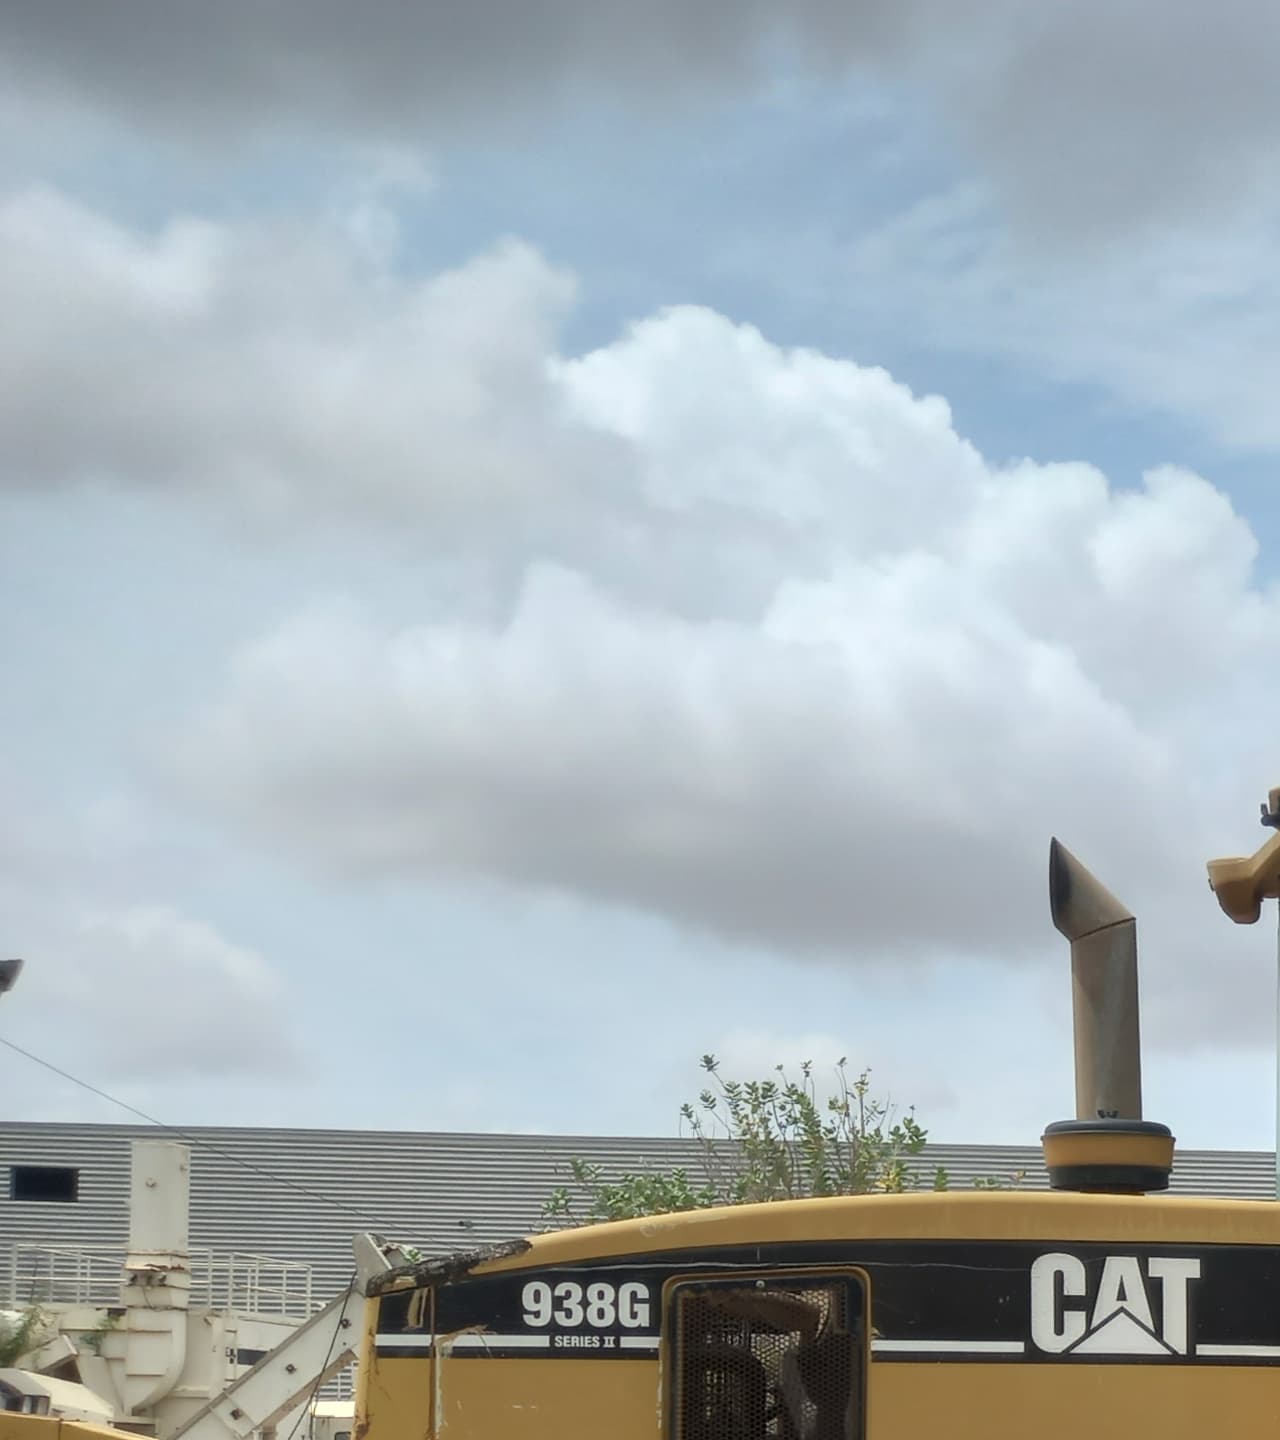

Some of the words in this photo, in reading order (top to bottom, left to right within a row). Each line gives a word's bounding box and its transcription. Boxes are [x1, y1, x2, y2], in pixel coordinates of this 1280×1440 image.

[521, 1281, 650, 1328] 938G
[1031, 1252, 1201, 1355] CAT
[554, 1335, 600, 1348] SERIES
